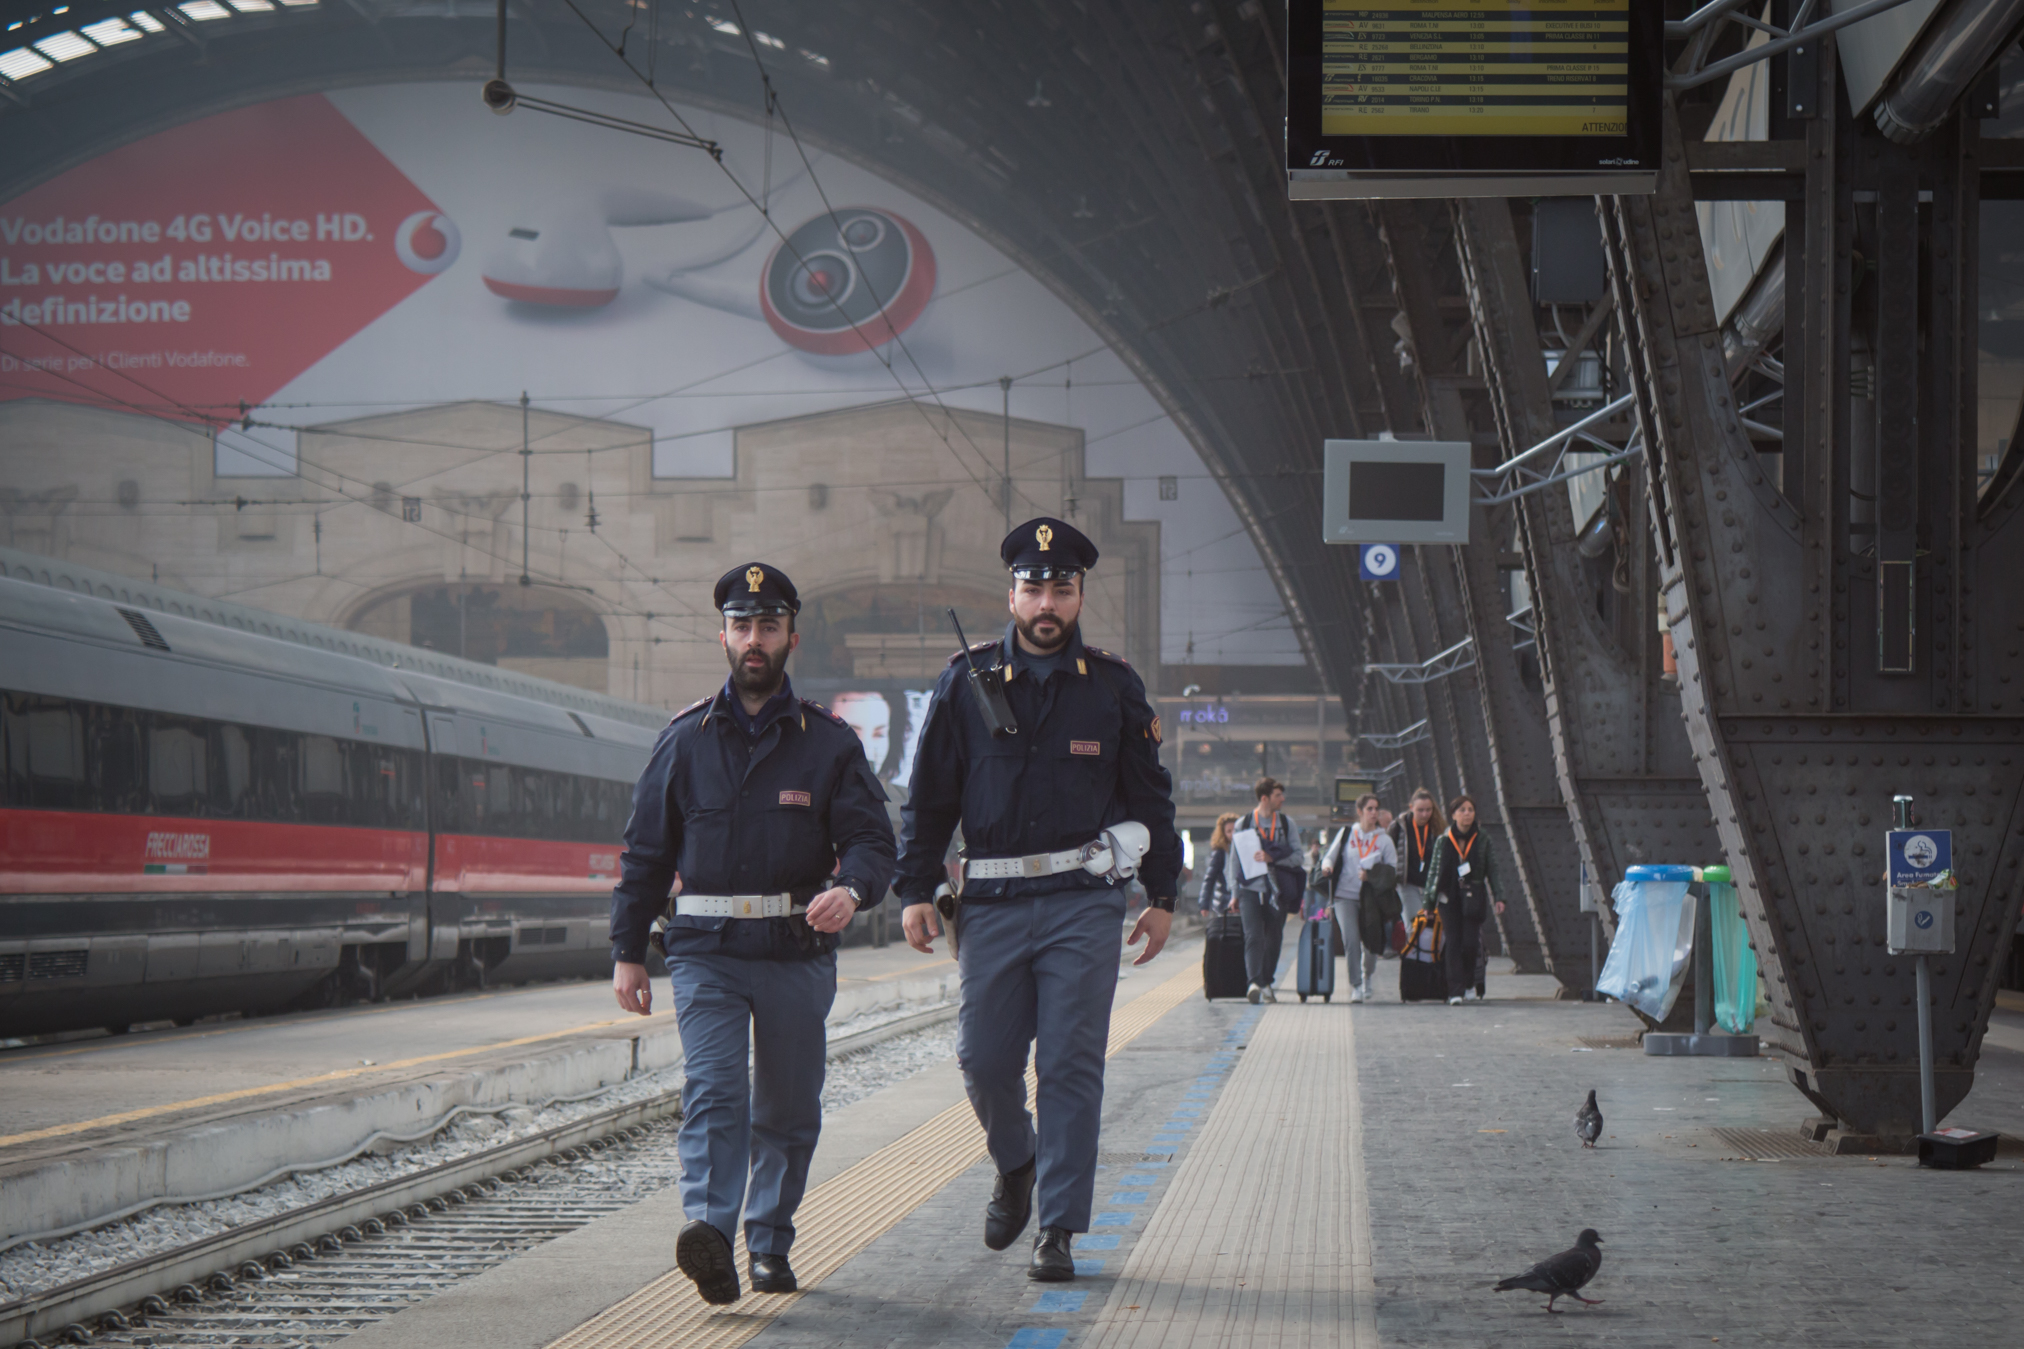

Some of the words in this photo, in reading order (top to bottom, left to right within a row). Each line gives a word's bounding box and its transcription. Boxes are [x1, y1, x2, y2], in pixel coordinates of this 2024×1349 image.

[0, 214, 161, 245] Vodafone
[165, 212, 212, 242] 4G
[216, 212, 310, 242] Voice
[316, 211, 374, 241] HD.
[0, 256, 40, 285] La
[45, 261, 126, 284] voce
[131, 253, 172, 283] ad
[177, 251, 332, 282] altissima
[0, 294, 191, 326] definizione
[1, 355, 19, 371] Di
[23, 355, 63, 371] serie
[67, 355, 95, 373] per
[106, 351, 162, 369] Clienti
[164, 350, 250, 368] Vodafone.
[1374, 552, 1386, 569] 9
[1072, 744, 1098, 752] POLIZIA
[781, 794, 809, 803] POLIZIA
[145, 832, 211, 858] FRECCIAROSSA
